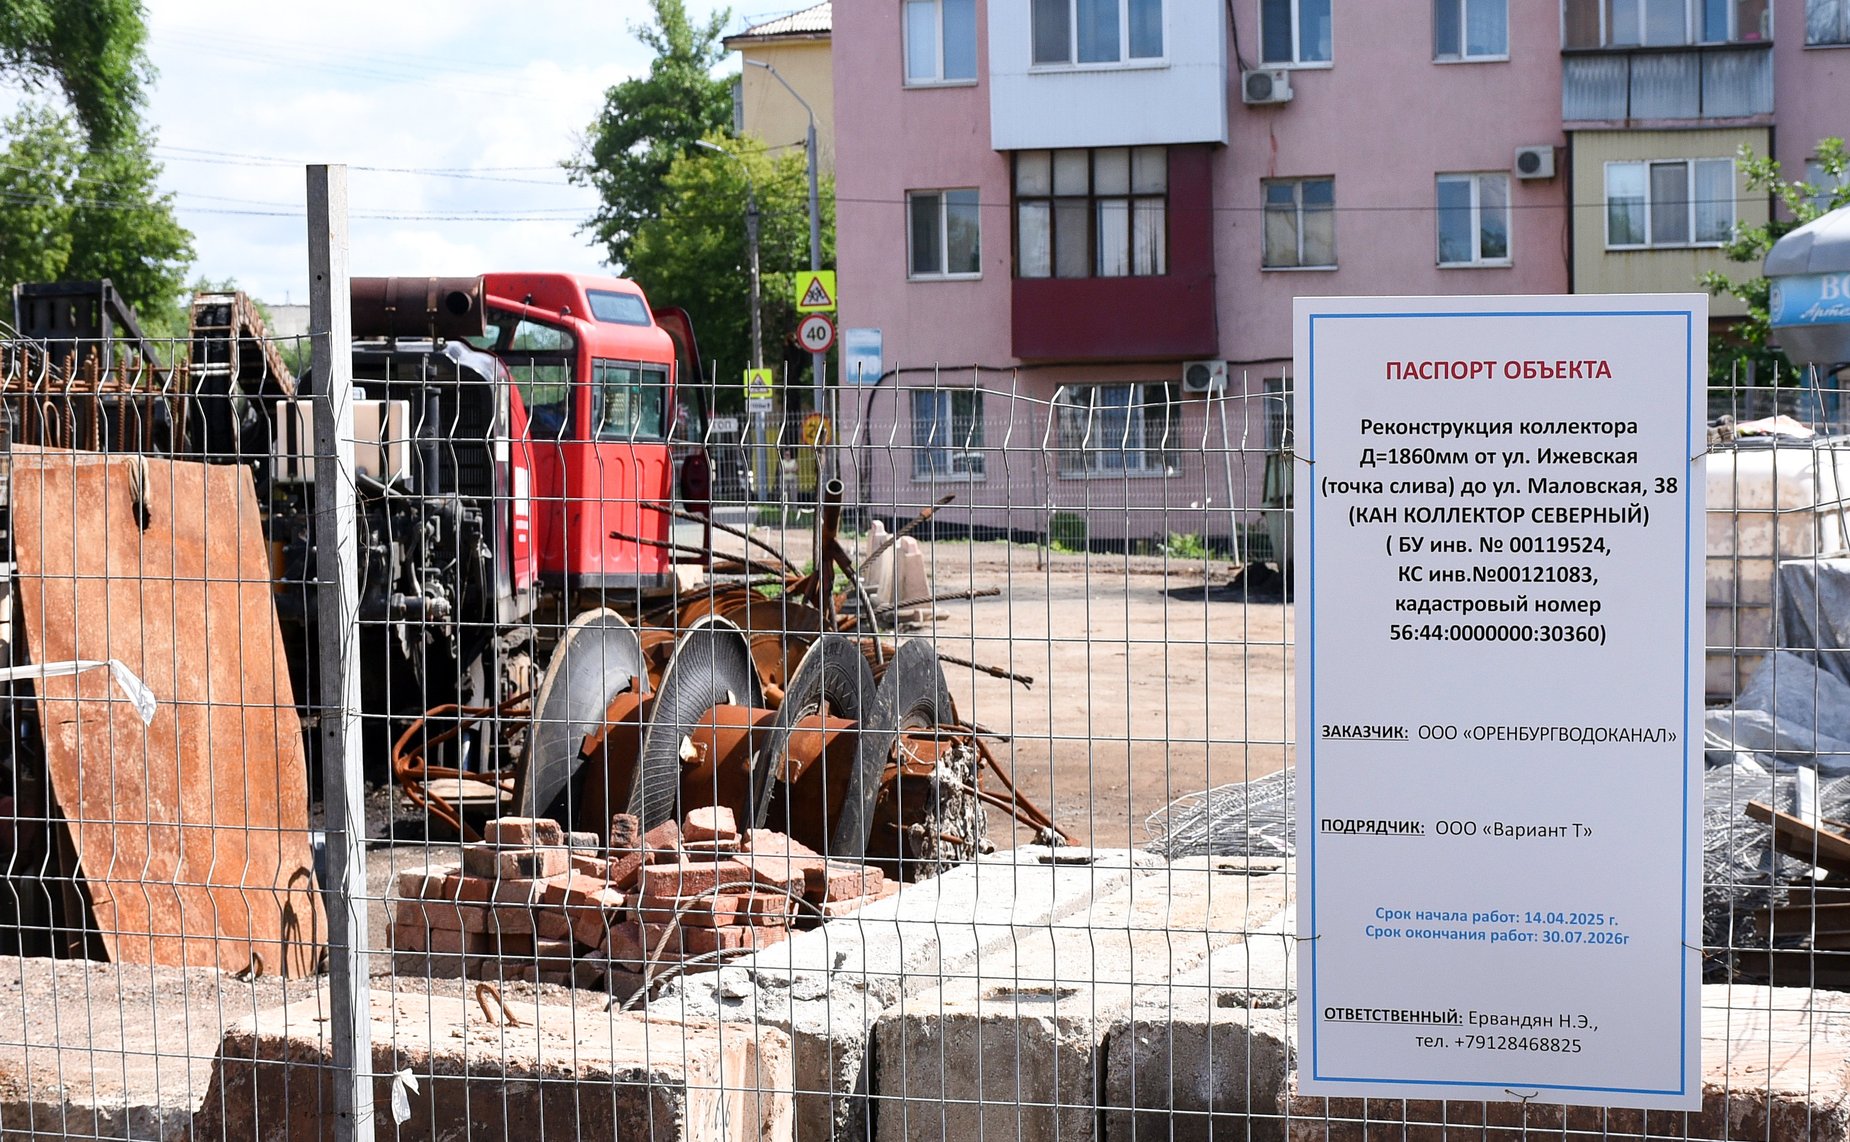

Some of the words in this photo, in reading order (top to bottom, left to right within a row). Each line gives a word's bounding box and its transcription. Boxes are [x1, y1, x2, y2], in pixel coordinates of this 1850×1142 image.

[807, 326, 826, 340] 40
[1386, 361, 1497, 380] ПАСПОРТ
[1503, 360, 1612, 379] ОБЪЕКТА
[1361, 418, 1513, 439] Реконструкция
[1519, 421, 1638, 438] коллектора
[1359, 447, 1469, 468] Д=1860мм
[1474, 451, 1497, 465] от
[1501, 451, 1531, 468] ул.
[1537, 447, 1638, 464] Ижевская
[1321, 476, 1384, 498] (точка
[1389, 476, 1455, 498] слива)
[1460, 481, 1487, 497] до
[1492, 481, 1521, 498] ул.
[1528, 477, 1648, 496] Маловская,
[1654, 476, 1678, 494] 38
[1348, 505, 1397, 527] (КАН
[1404, 506, 1526, 524] КОЛЛЕКТОР
[1531, 502, 1650, 528] СЕВЕРНЫЙ)
[1399, 536, 1425, 553] БУ
[1430, 540, 1473, 553] инв.
[1479, 536, 1504, 553] №
[1509, 536, 1611, 557] 00119524,
[1398, 565, 1423, 583] КС
[1395, 594, 1528, 616] кадастровый
[1534, 599, 1602, 617] номер
[1389, 624, 1607, 647] 56:44:0000000:30360)
[1321, 724, 1409, 741] ЗАКАЗЧИК:
[1418, 724, 1458, 741] ООО
[1463, 725, 1677, 746] «ОРЕНБУРГВОДОКАНАЛ»
[1321, 818, 1425, 836] ПОДРЯДЧИК:
[1435, 820, 1477, 836] ООО
[1482, 821, 1568, 841] «Вариант
[1571, 822, 1593, 838] Т»
[1375, 906, 1412, 923] Срок
[1415, 911, 1468, 922] начала
[1472, 909, 1520, 925] работ:
[1524, 911, 1605, 926] 14.04.2025
[1609, 916, 1619, 926] г.
[1365, 924, 1402, 940] Срок
[1405, 928, 1486, 941] окончания
[1490, 928, 1538, 944] работ:
[1542, 930, 1630, 945] 30.07.2026г
[1324, 1007, 1463, 1026] ОТВЕТСТВЕННЫЙ:
[1468, 1010, 1553, 1030] Ервандян
[1559, 1013, 1598, 1033] Н.Э.,
[1415, 1036, 1449, 1049] тел.
[1454, 1034, 1582, 1054] +79128468825
